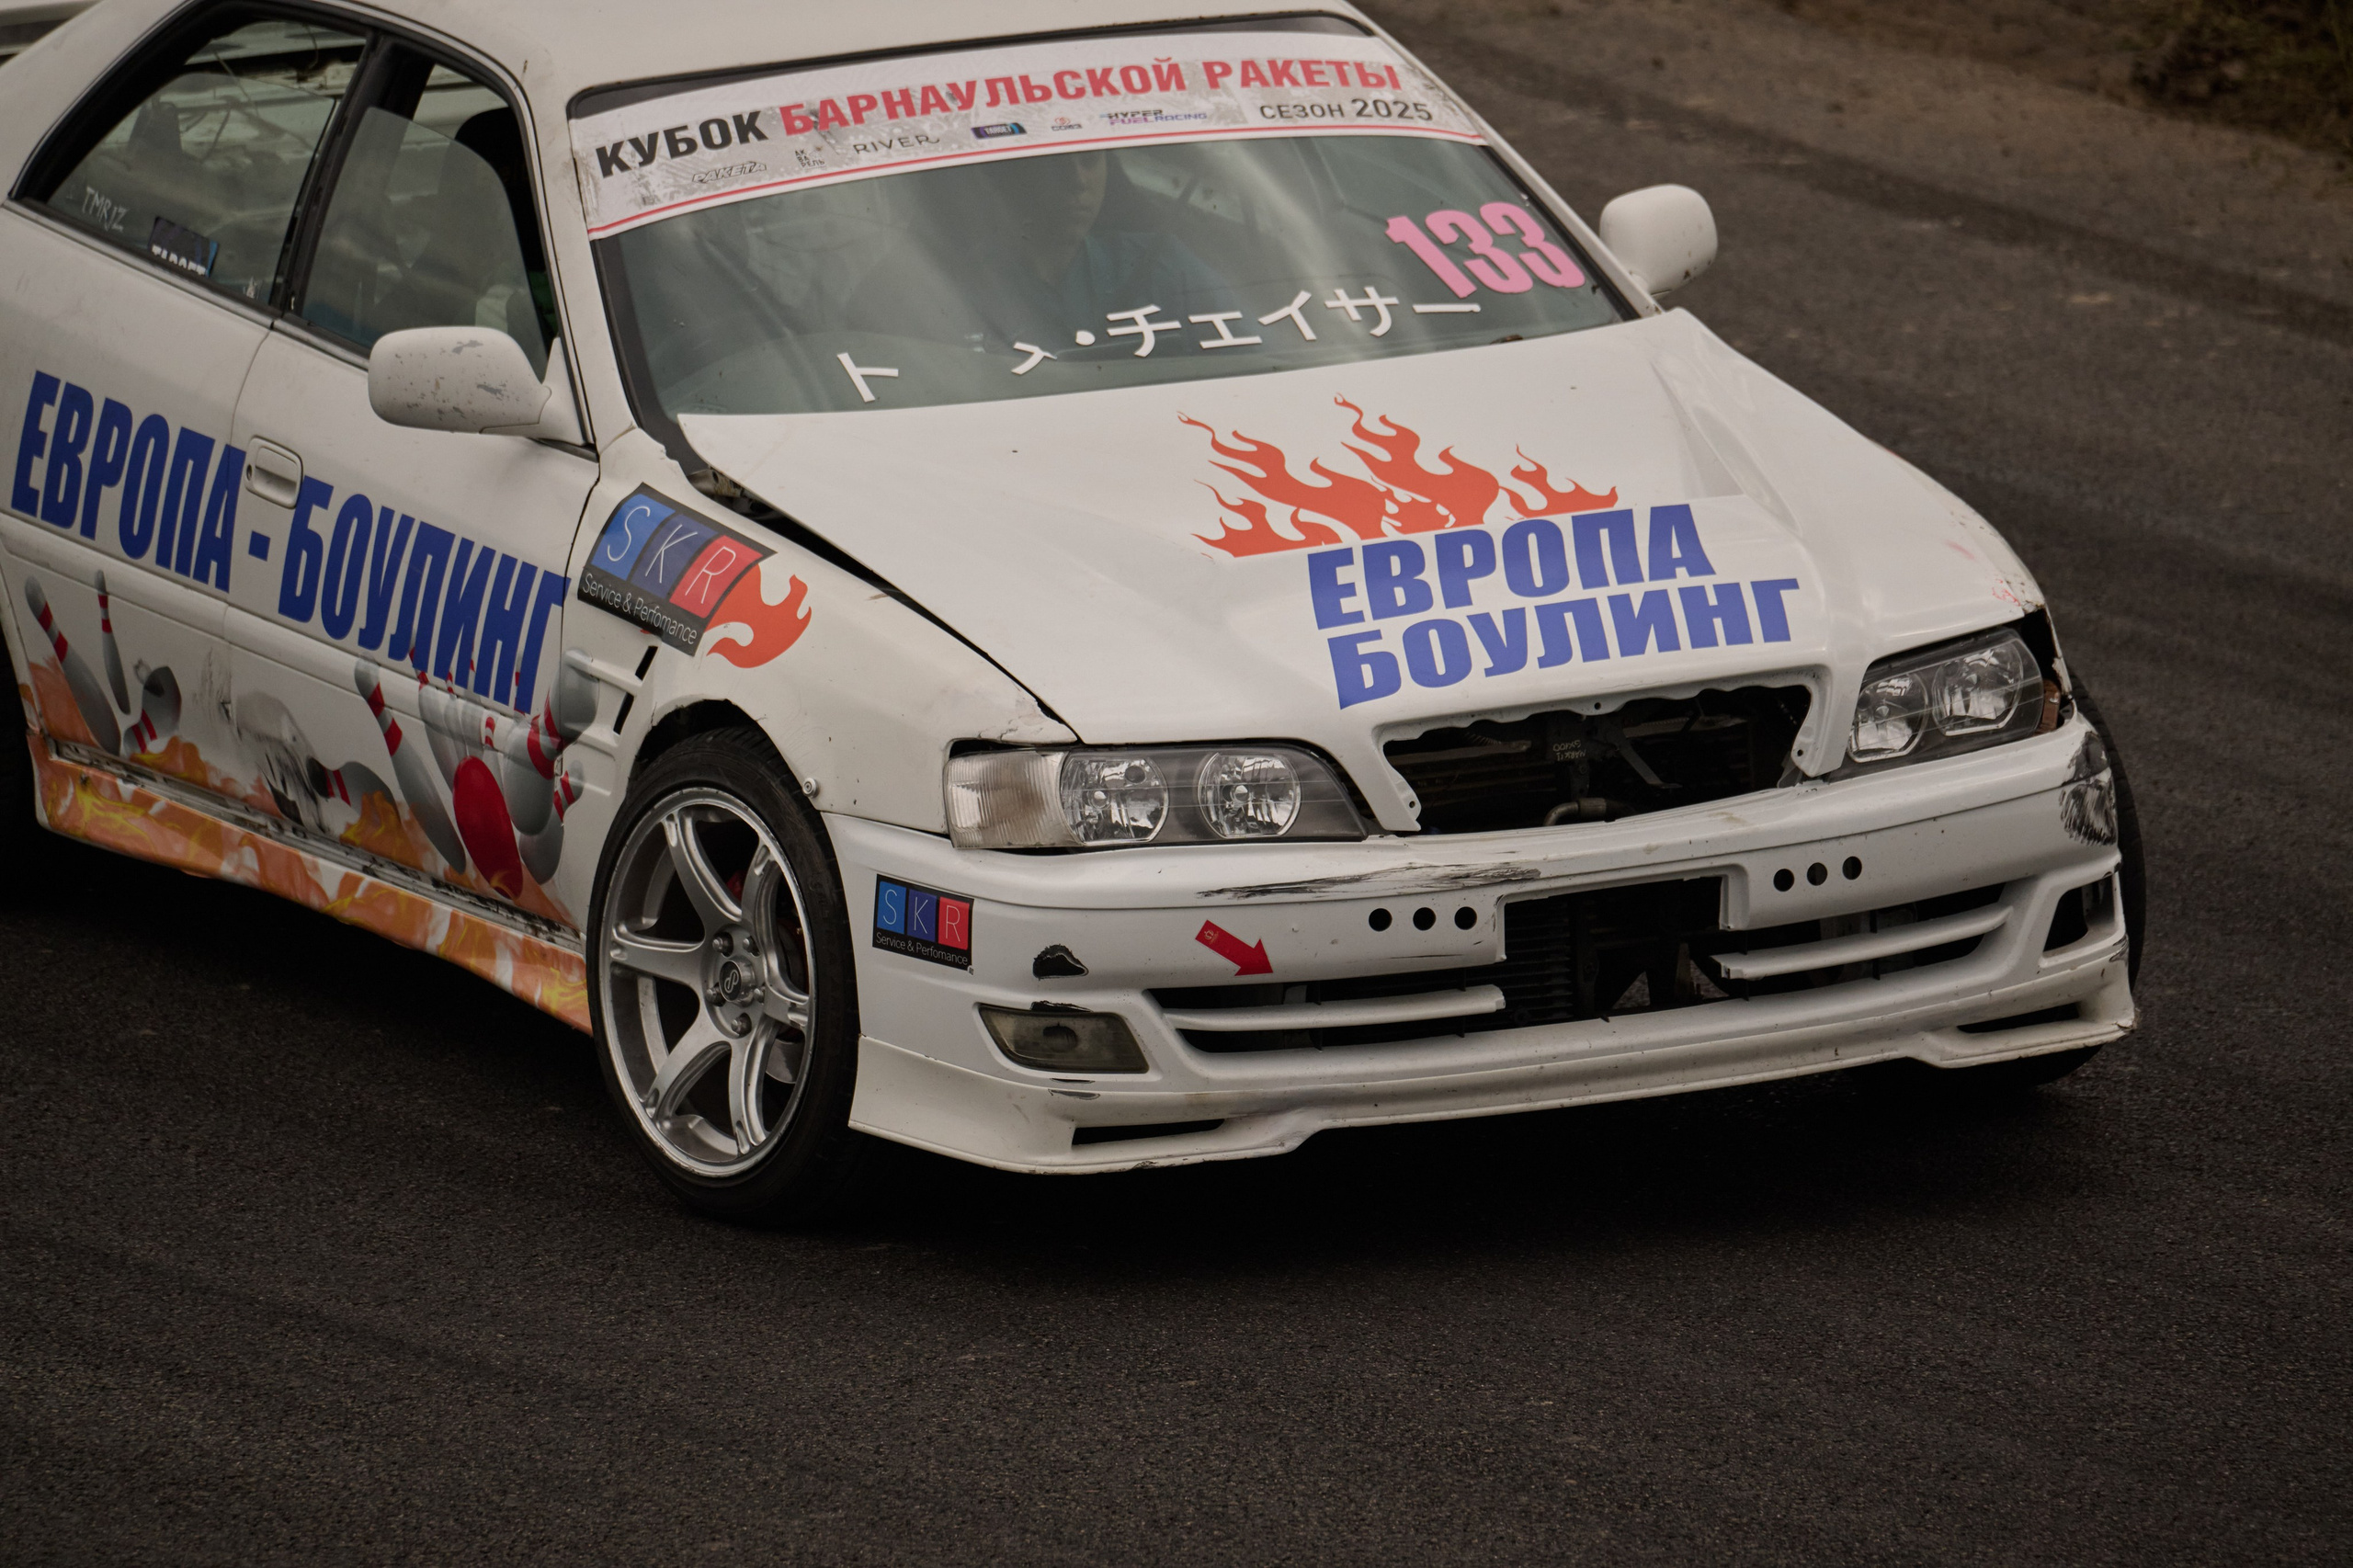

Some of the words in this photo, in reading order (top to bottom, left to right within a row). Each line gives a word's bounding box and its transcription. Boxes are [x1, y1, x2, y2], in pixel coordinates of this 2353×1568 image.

[596, 110, 769, 179] КУБОК
[779, 57, 1188, 136] БАРНАУЛЬСКОЙ
[1203, 58, 1403, 92] РАКЕТЫ
[853, 135, 939, 154] RIVER
[1259, 101, 1346, 121] СЕЗОН
[1350, 97, 1434, 121] 2025
[1386, 202, 1586, 299] 133
[11, 369, 246, 593] ЕВРОПА
[278, 474, 572, 714] БОУЛИНГ
[607, 505, 737, 605] SKR
[1307, 503, 1716, 631] ЕВРОПА
[582, 573, 622, 608] Service
[622, 592, 632, 614] &
[633, 597, 699, 645] Perfomance
[1327, 578, 1800, 710] БОУЛИНГ
[876, 931, 906, 951] Service
[906, 939, 915, 953] &
[915, 941, 969, 966] Perfomance
[882, 889, 961, 943] SKR
